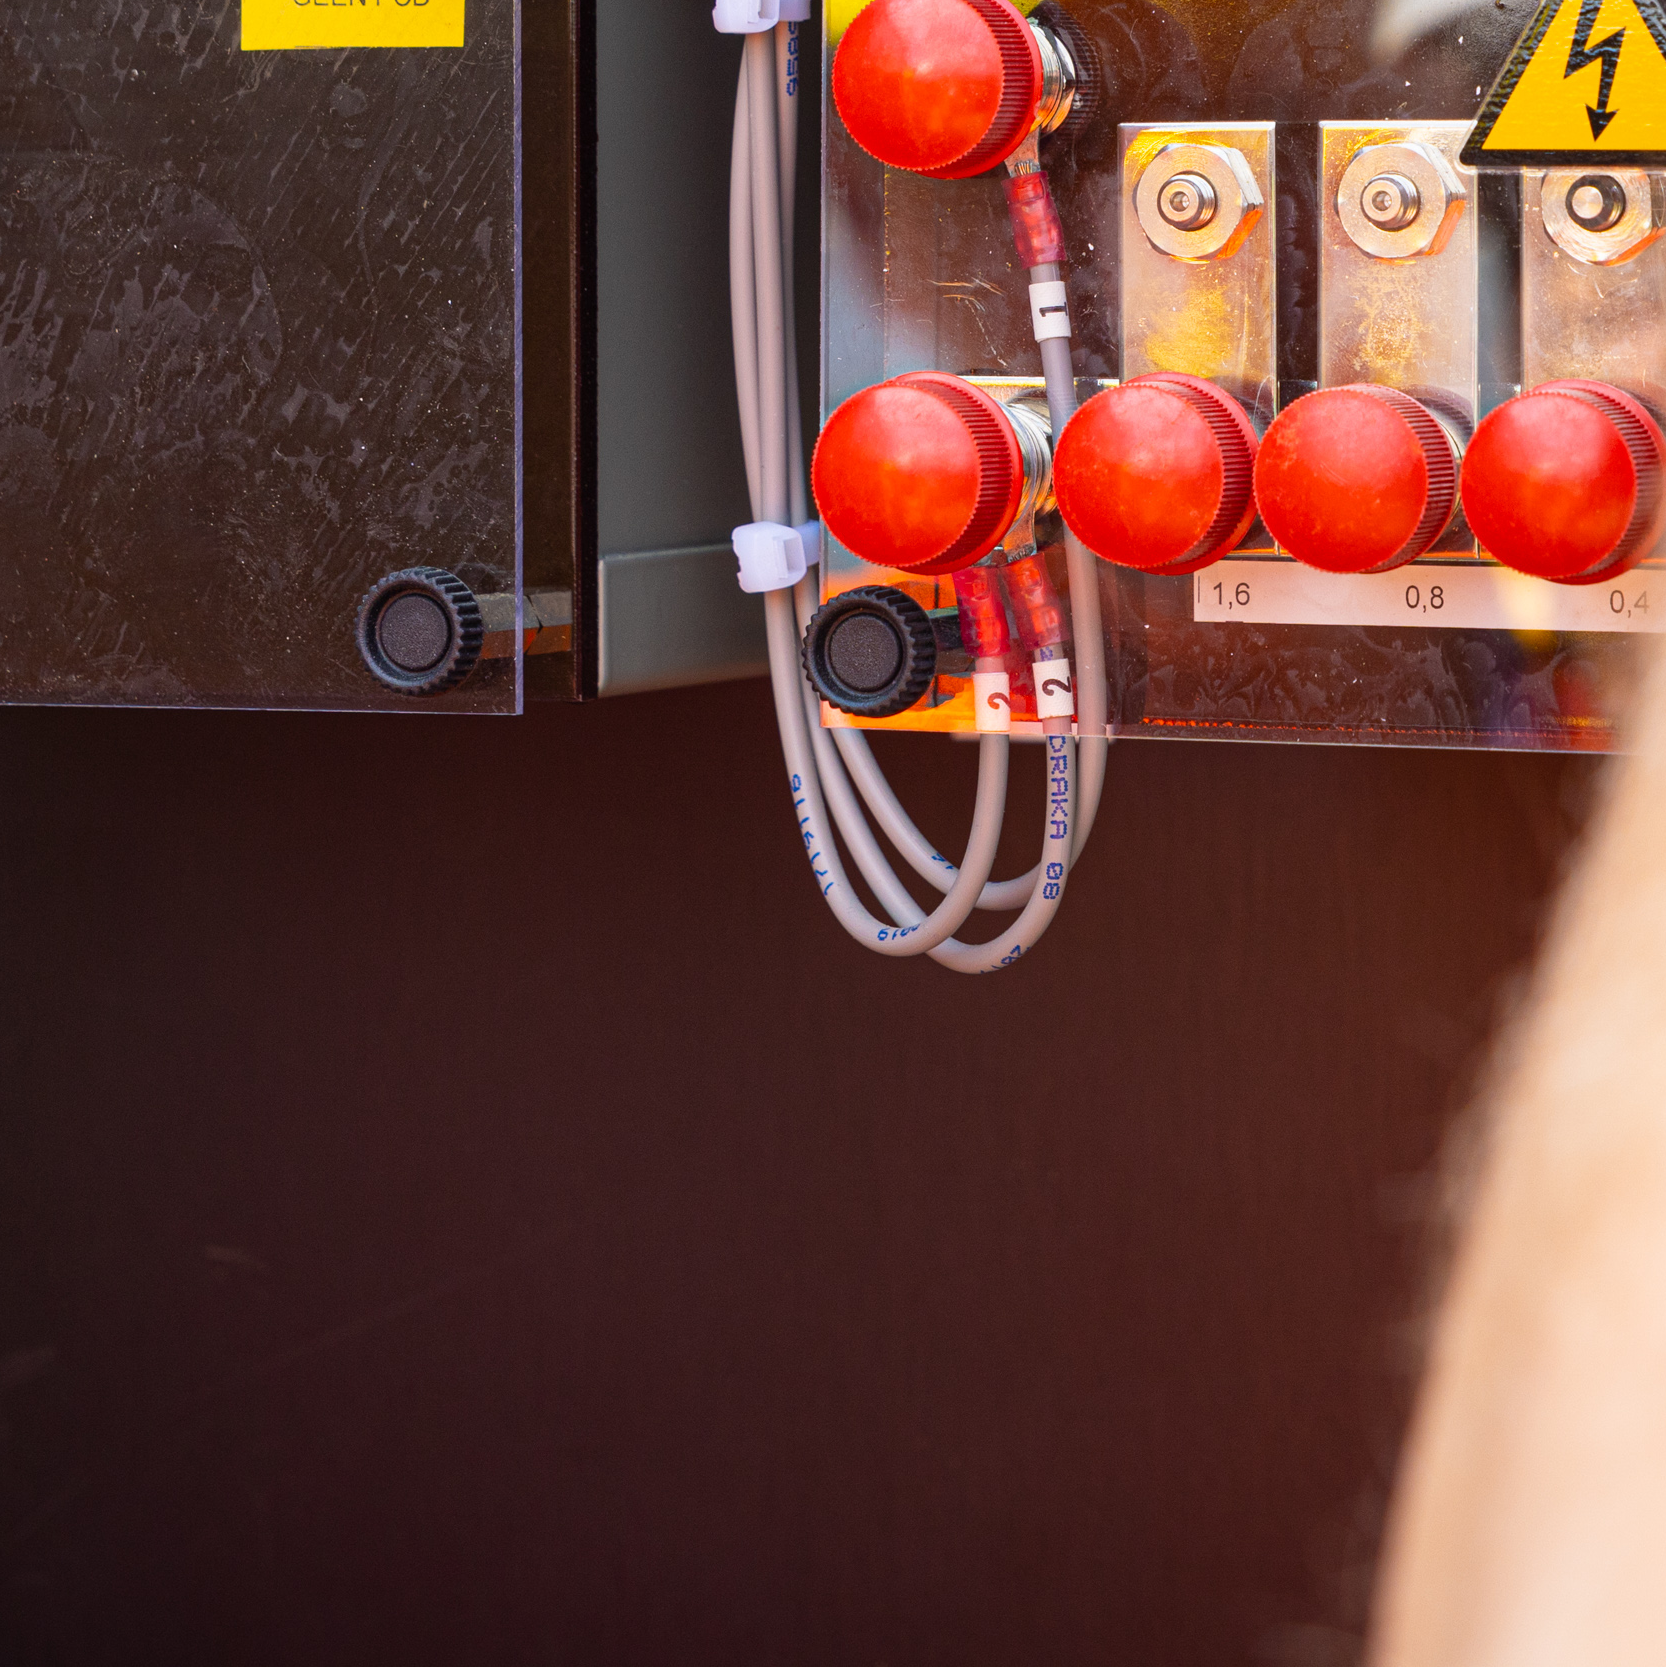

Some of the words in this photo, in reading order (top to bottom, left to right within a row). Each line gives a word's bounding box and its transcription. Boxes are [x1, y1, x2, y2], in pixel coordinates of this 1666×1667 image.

[1040, 301, 1070, 316] 1
[1213, 582, 1250, 609] 1,6
[1405, 585, 1445, 613] 0,8
[1609, 589, 1649, 616] 0,4
[1042, 676, 1071, 697] 2
[987, 692, 1011, 711] 2
[1048, 736, 1069, 840] DRAKA
